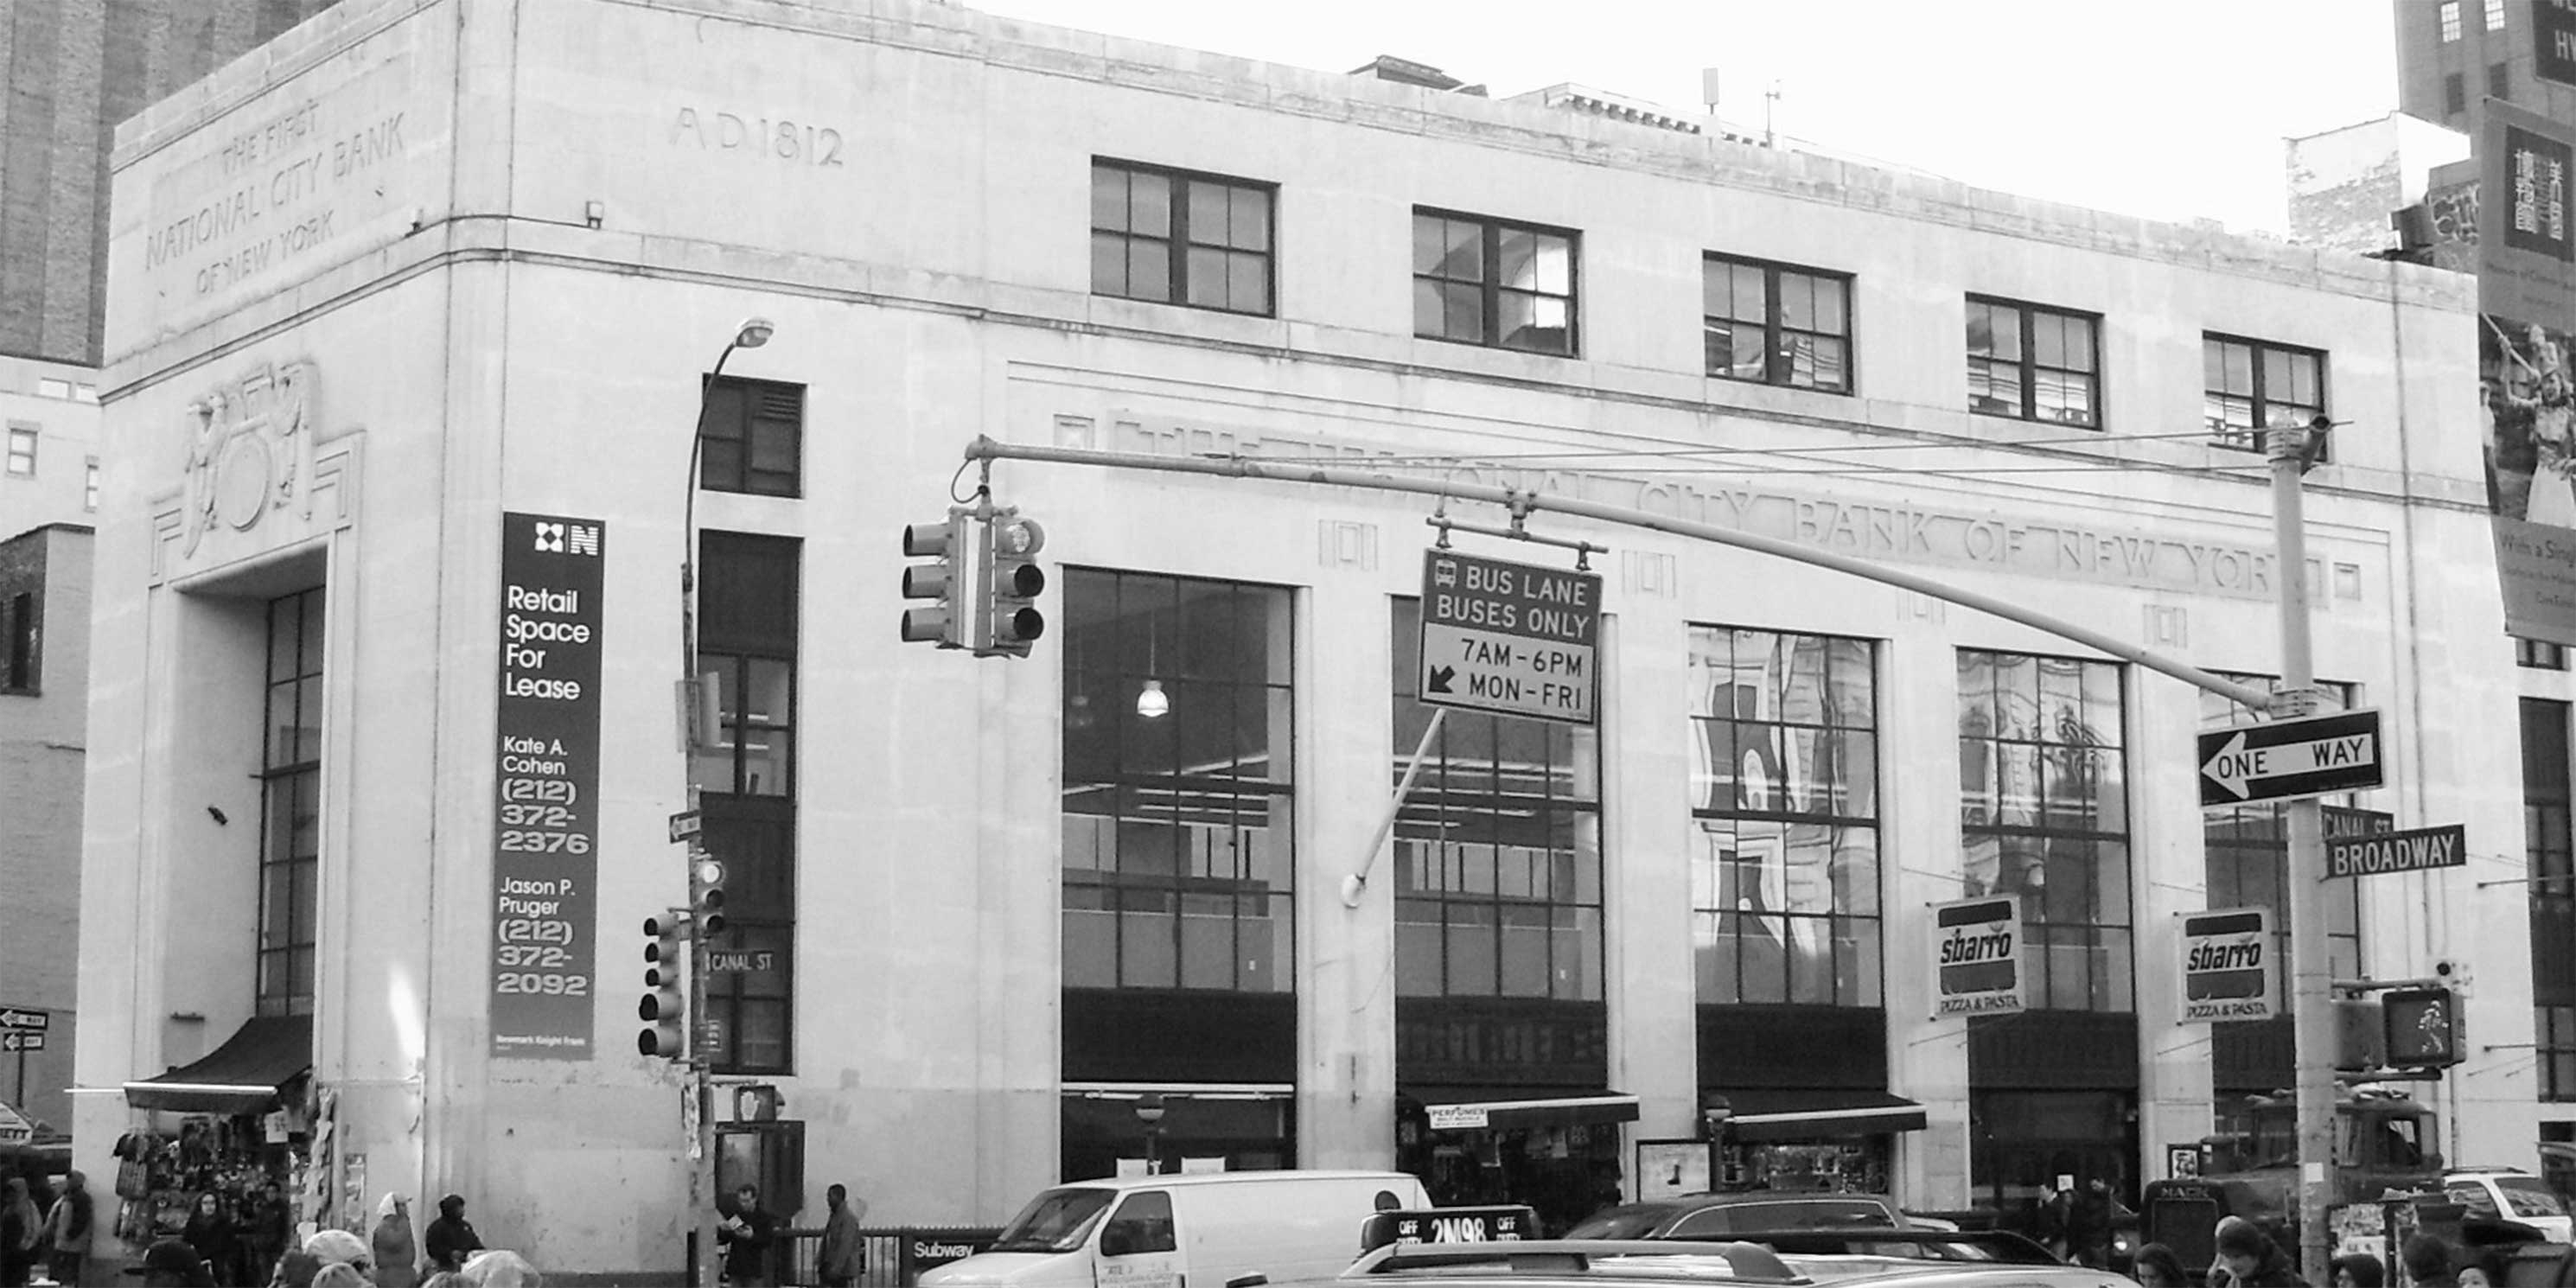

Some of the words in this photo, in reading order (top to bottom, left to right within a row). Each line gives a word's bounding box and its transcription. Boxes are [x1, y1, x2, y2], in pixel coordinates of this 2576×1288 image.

[222, 135, 257, 174] THE
[265, 102, 319, 154] FIRST
[146, 186, 260, 272] NATIONAL
[271, 152, 322, 207] CITY
[334, 112, 404, 179] BANK
[196, 261, 222, 294] OF
[223, 239, 271, 284] NEW
[279, 209, 334, 260] YORK
[1639, 481, 1759, 529] CITY
[1795, 495, 1934, 553] BANK
[1963, 518, 2027, 564] OF
[2057, 528, 2156, 577] NEW
[2182, 544, 2280, 593] YOR
[1466, 564, 1513, 595] BUS
[1523, 574, 1588, 606] LANE
[507, 584, 578, 614] Retail
[506, 613, 590, 644] Space
[1437, 594, 1517, 628] BUSES
[1527, 608, 1590, 639] ONLY
[506, 643, 546, 670] For
[506, 671, 582, 700] Lease
[503, 736, 545, 755] Kate
[549, 738, 569, 756] A.
[2217, 750, 2269, 779] ONE
[2311, 737, 2364, 768] WAY
[502, 755, 566, 775] Cohen
[501, 778, 577, 806] (212)
[501, 804, 577, 827] 372-
[2324, 813, 2364, 838] CANAL
[2374, 818, 2390, 835] ST
[500, 830, 590, 855] 2376
[2334, 833, 2456, 876] BROADWAY
[500, 877, 556, 896] Jason
[559, 878, 576, 896] P.
[498, 896, 560, 919] Pruger
[497, 918, 574, 946] (212)
[497, 945, 574, 968] 372-
[1940, 928, 2012, 964] sbarro
[2187, 941, 2262, 971] sbarro
[711, 953, 753, 972] CANAL
[756, 953, 774, 971] ST
[496, 972, 588, 996] 2092
[1940, 998, 1973, 1013] PIZZA
[1973, 998, 1983, 1011] &
[1984, 995, 2020, 1010] PASTA
[2186, 1004, 2220, 1018] PIZZA
[2221, 1004, 2230, 1017] &
[2232, 1002, 2268, 1016] PASTA
[2161, 1187, 2209, 1198] MACK
[1398, 1220, 1419, 1235] OFF
[1431, 1217, 1487, 1244] 2M98
[1497, 1216, 1515, 1231] OFF
[914, 1241, 974, 1259] Subway
